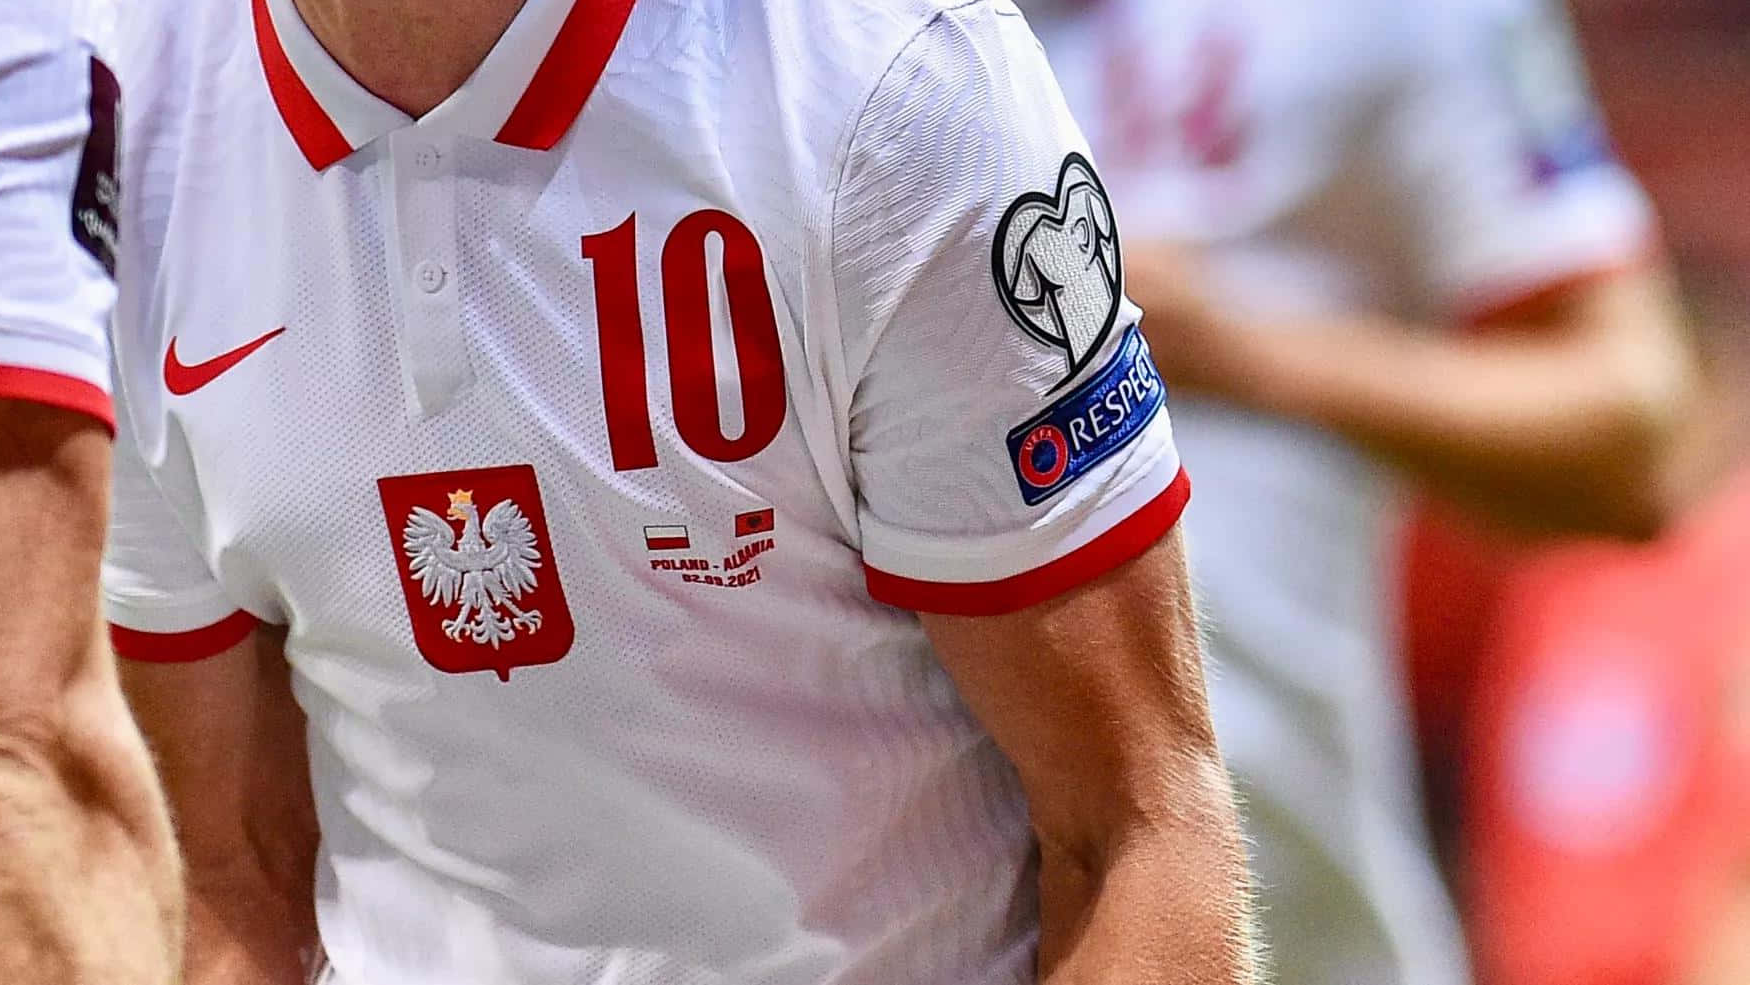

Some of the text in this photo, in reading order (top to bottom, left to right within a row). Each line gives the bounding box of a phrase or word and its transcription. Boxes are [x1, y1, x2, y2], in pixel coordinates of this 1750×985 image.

[580, 208, 787, 473] 10
[1025, 429, 1053, 451] UEFA
[650, 559, 709, 571] POLAND
[723, 537, 775, 571] ALBANIA
